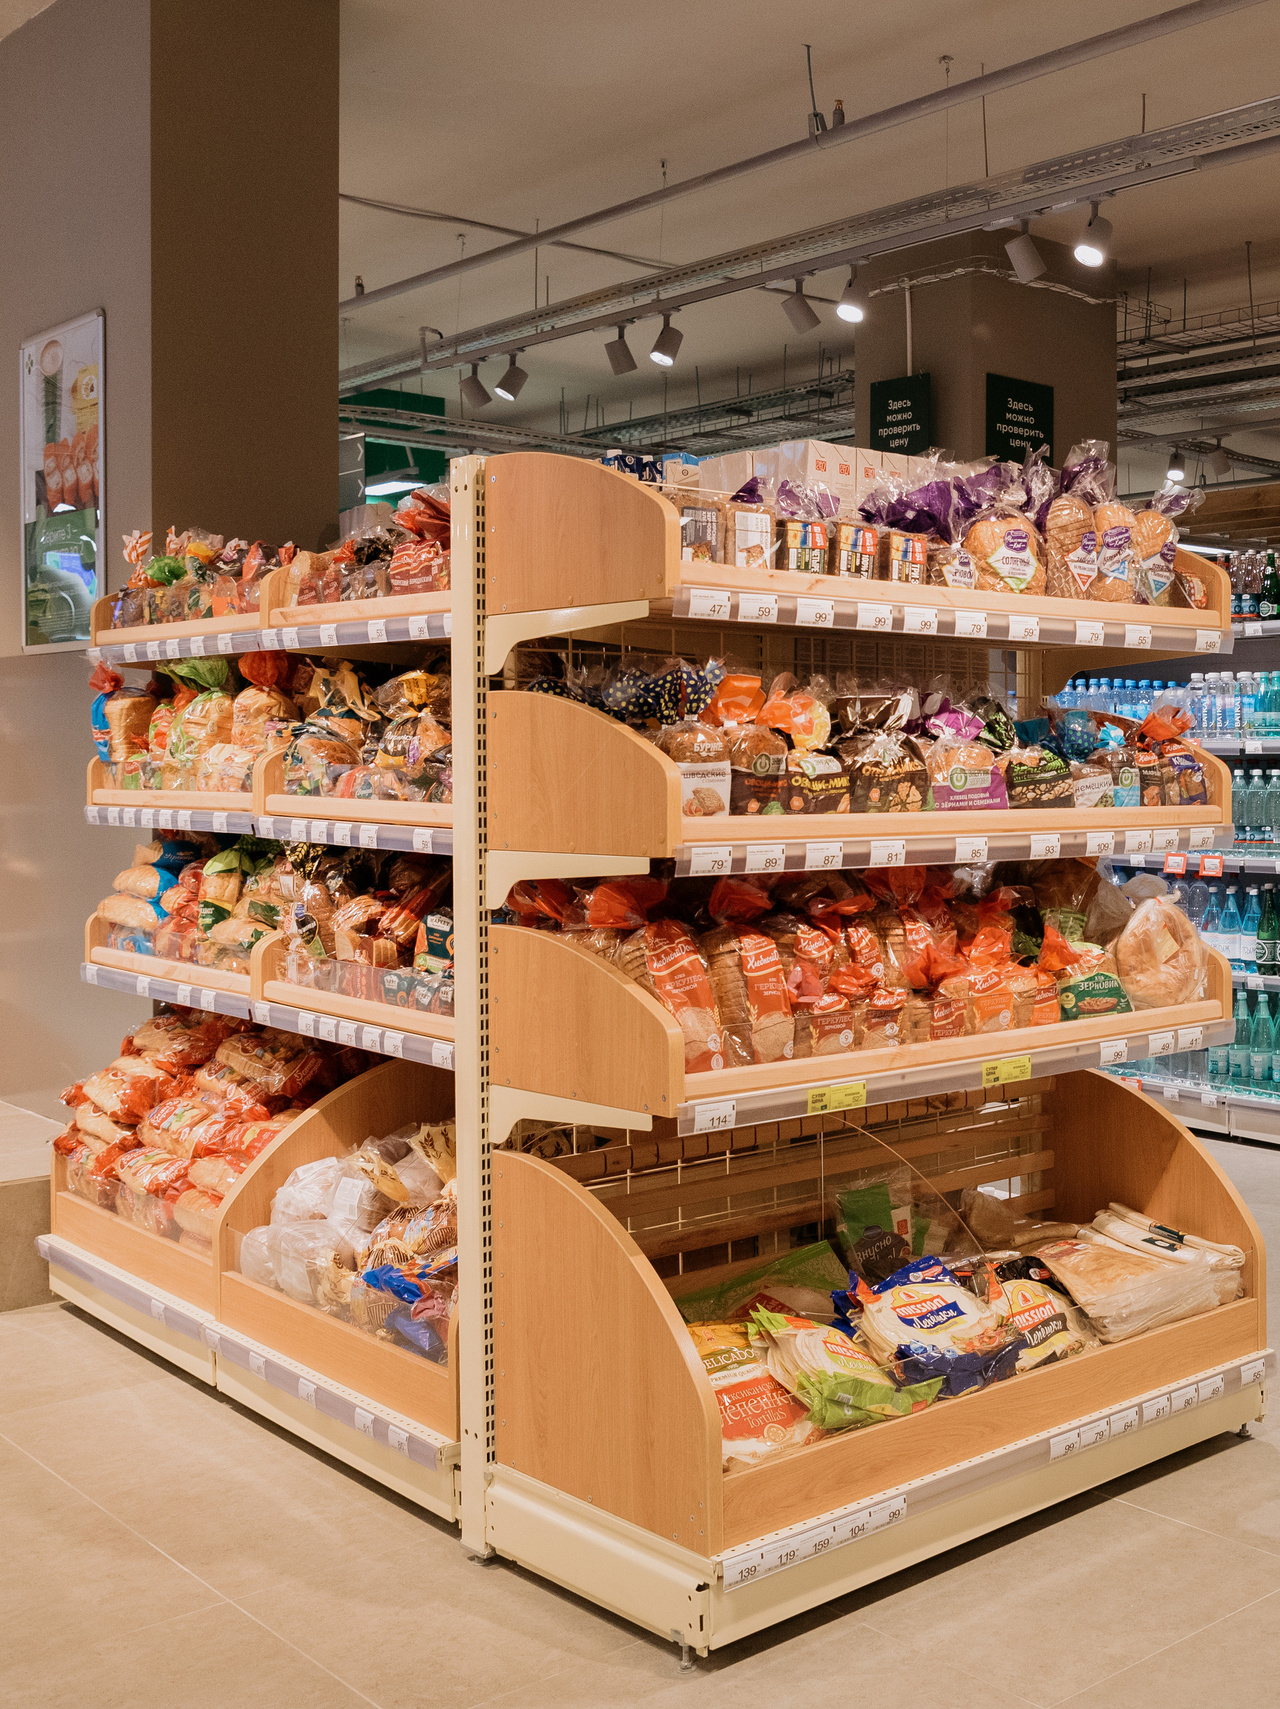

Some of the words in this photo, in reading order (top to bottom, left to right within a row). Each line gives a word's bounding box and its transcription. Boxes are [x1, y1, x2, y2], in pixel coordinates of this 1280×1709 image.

[888, 399, 911, 410] Здесь
[1007, 398, 1034, 412] Здесь
[886, 411, 912, 422] можно
[1006, 412, 1035, 424] можно
[878, 423, 921, 437] проверить
[996, 423, 1044, 439] проверить
[889, 437, 909, 448] цену
[1009, 437, 1032, 449] цену
[710, 604, 723, 615] 47
[758, 606, 771, 617] 59
[815, 612, 828, 623] 99
[874, 616, 887, 627] 99
[920, 620, 931, 631] 99
[971, 624, 982, 634] 79
[1024, 628, 1035, 638] 59
[1090, 632, 1100, 642] 79
[1138, 636, 1147, 645] 55
[1204, 641, 1216, 650] 149
[693, 742, 723, 752] БУРЖЕ
[967, 791, 990, 800] ПОДОВЫЙ
[940, 801, 968, 809] ЗЁРНАМИ
[1137, 841, 1147, 850] 81
[1165, 838, 1175, 848] 99
[1201, 837, 1210, 845] 87
[1044, 845, 1055, 855] 93
[1097, 842, 1109, 852] 109
[887, 853, 898, 862] 81
[971, 848, 982, 858] 85
[711, 860, 724, 870] 79
[765, 858, 778, 868] 89
[824, 855, 836, 865] 87
[747, 951, 774, 970] Хлебный
[1078, 979, 1119, 991] ЗЕРНОВИК
[817, 1015, 852, 1025] ГЕРКУЛЕС
[1161, 1043, 1170, 1052] 49
[1189, 1038, 1198, 1046] 41
[1114, 1050, 1123, 1060] 99
[709, 1115, 728, 1127] 114
[710, 1371, 738, 1382] PREMIUM
[738, 1364, 763, 1377] QUALITY
[1252, 1371, 1261, 1382] 55
[1210, 1386, 1220, 1396] 49
[1183, 1397, 1193, 1407] 80
[1155, 1406, 1166, 1417] 81
[1123, 1420, 1134, 1431] 64
[1094, 1430, 1105, 1441] 79
[1064, 1442, 1075, 1454] 99
[888, 1508, 901, 1521] 99
[848, 1523, 866, 1537] 104
[812, 1537, 830, 1552] 159
[777, 1549, 796, 1564] 119
[738, 1565, 757, 1580] 139
